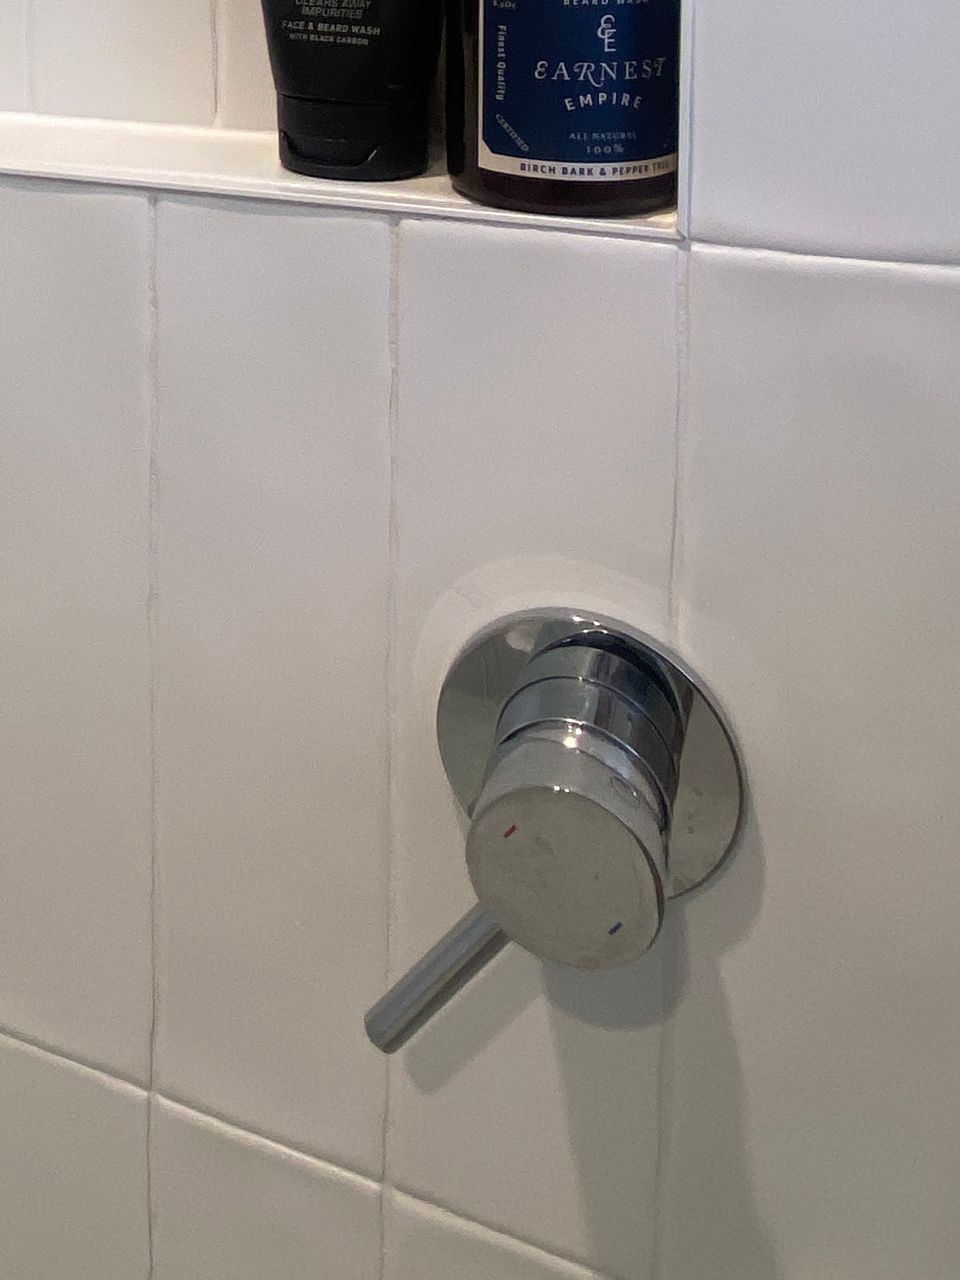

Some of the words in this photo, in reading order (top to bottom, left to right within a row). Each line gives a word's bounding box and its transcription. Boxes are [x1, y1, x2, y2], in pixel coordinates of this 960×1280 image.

[341, 0, 372, 9] AWAY
[302, 6, 363, 19] IMPURITIES
[282, 20, 305, 30] FACE
[308, 22, 314, 30] &
[317, 22, 349, 33] BEARD
[352, 25, 381, 36] WASH
[535, 57, 666, 87] EARNEST
[564, 92, 642, 111] EMPIRE
[520, 163, 556, 174] BIRCH
[561, 166, 594, 177] BARK
[599, 167, 608, 176] &
[612, 164, 649, 176] PEPPER
